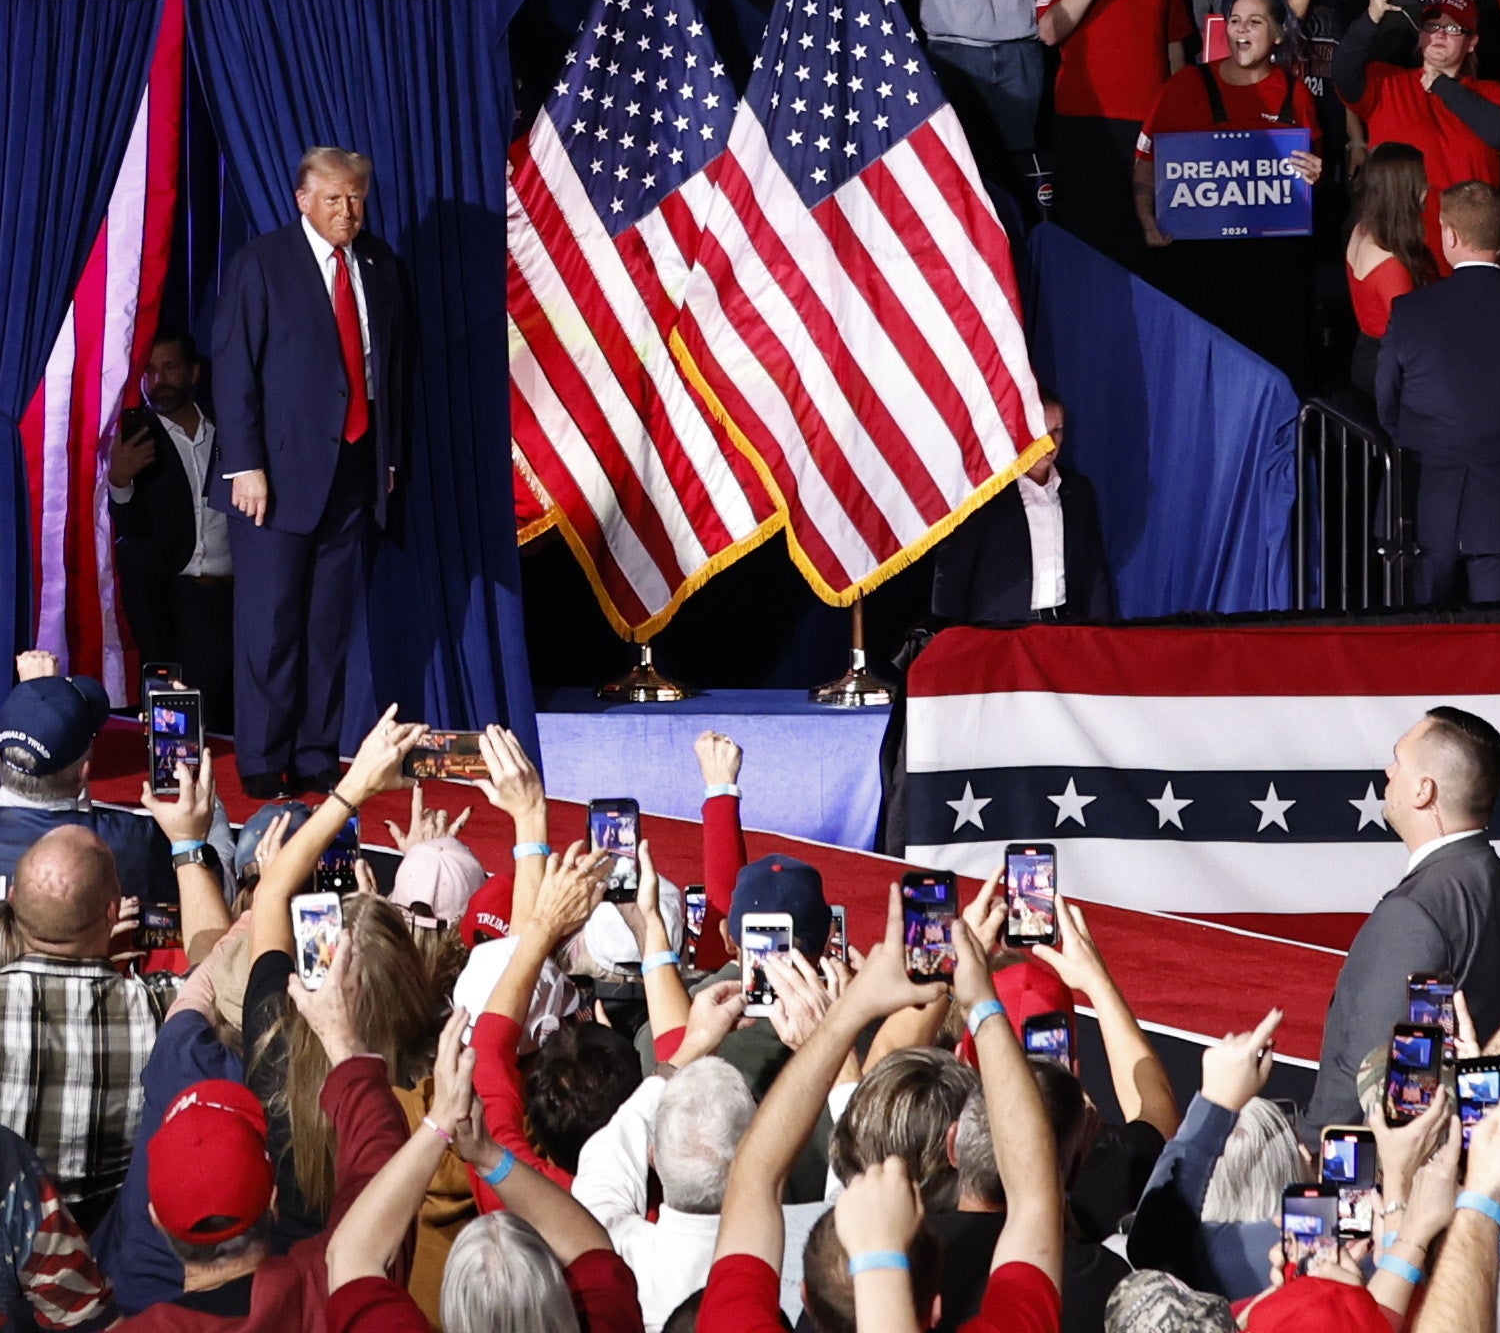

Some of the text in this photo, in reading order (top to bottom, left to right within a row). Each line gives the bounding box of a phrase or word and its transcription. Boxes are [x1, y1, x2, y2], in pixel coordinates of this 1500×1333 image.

[1166, 158, 1302, 181] DREAM BIG,
[1169, 178, 1293, 208] AGAIN!
[1221, 226, 1249, 236] 2024
[476, 912, 511, 937] TRUM
